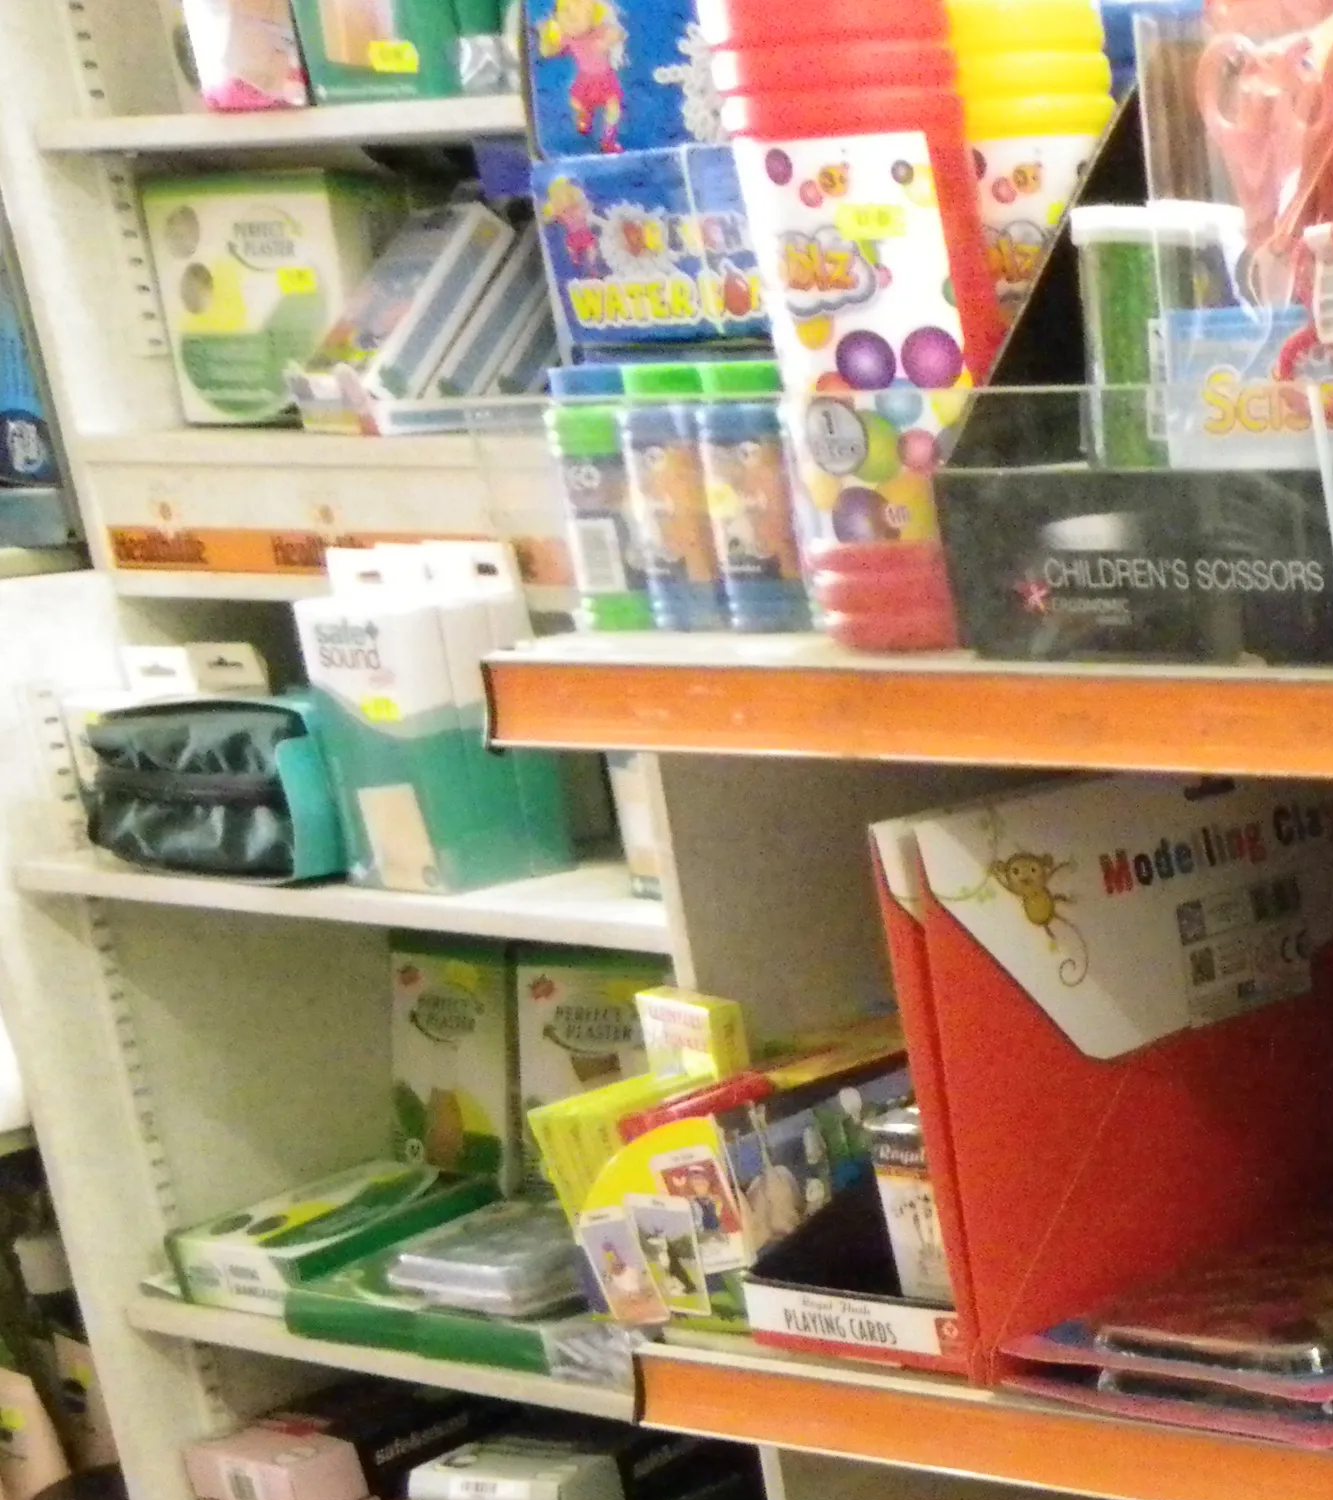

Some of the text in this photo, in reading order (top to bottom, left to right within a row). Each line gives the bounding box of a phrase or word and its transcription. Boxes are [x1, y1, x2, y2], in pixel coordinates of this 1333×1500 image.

[570, 280, 695, 322] WATER
[1044, 556, 1325, 592] CHILDREN'S SCISSORS
[783, 1307, 898, 1345] PLAYING CARDS
